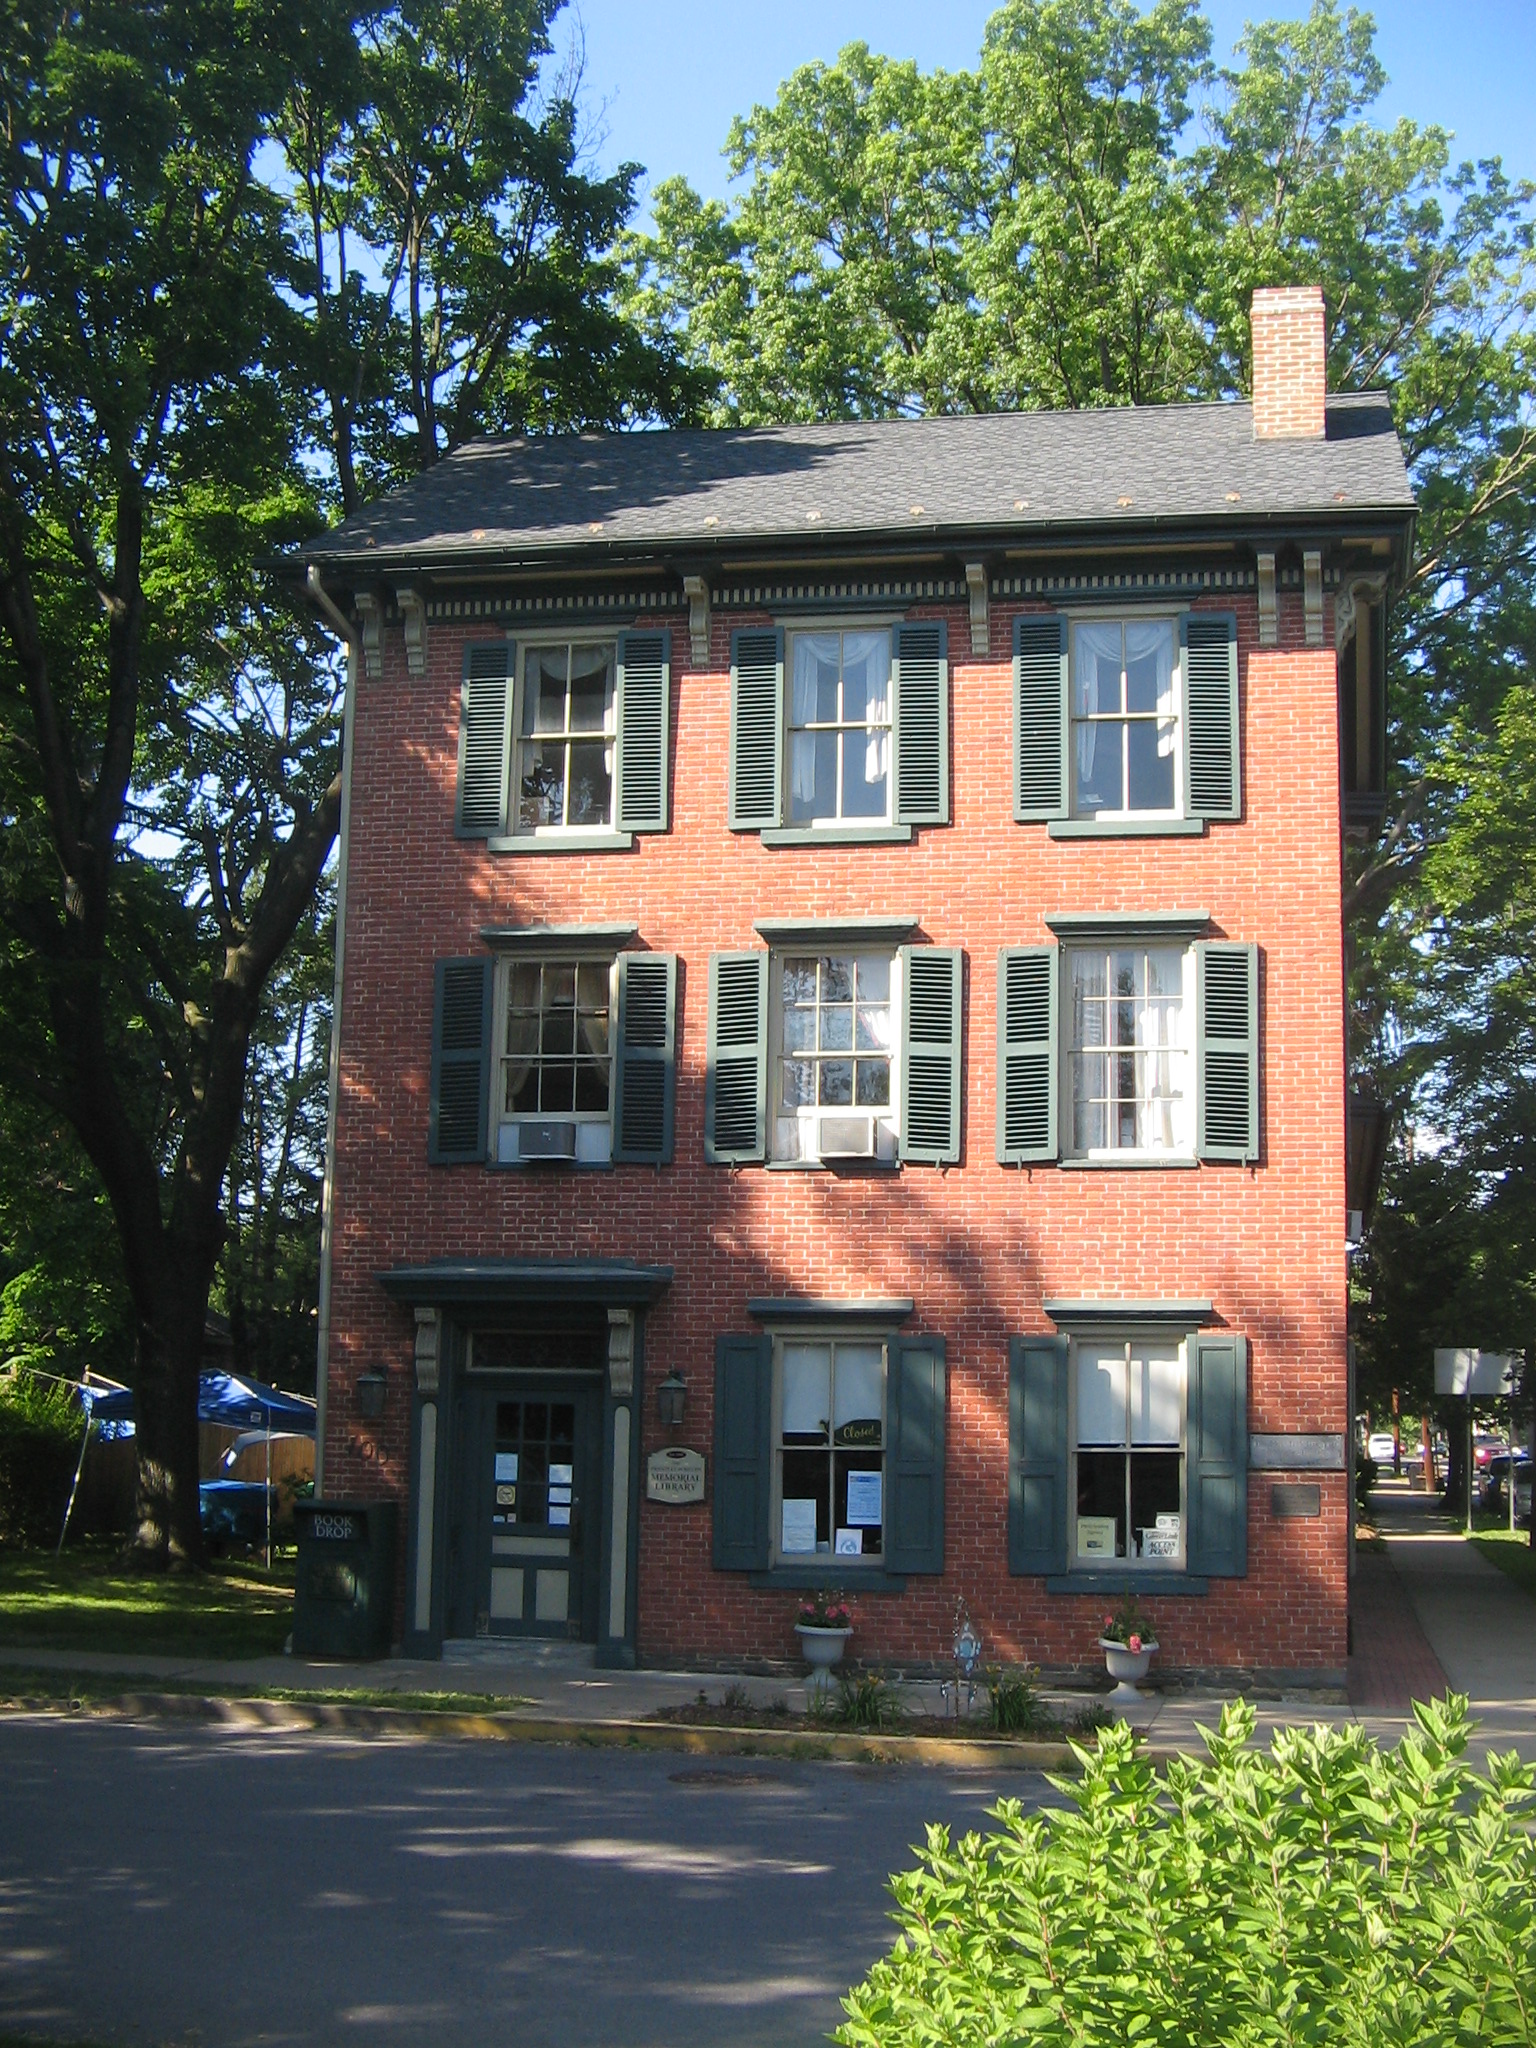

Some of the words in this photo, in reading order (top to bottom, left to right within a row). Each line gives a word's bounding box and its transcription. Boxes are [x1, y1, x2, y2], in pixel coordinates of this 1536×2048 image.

[843, 1425, 875, 1439] Closed
[651, 1473, 699, 1482] MEMORIAL
[655, 1483, 695, 1492] LIBRARY
[314, 1514, 353, 1526] BOOK
[316, 1526, 352, 1538] DROP
